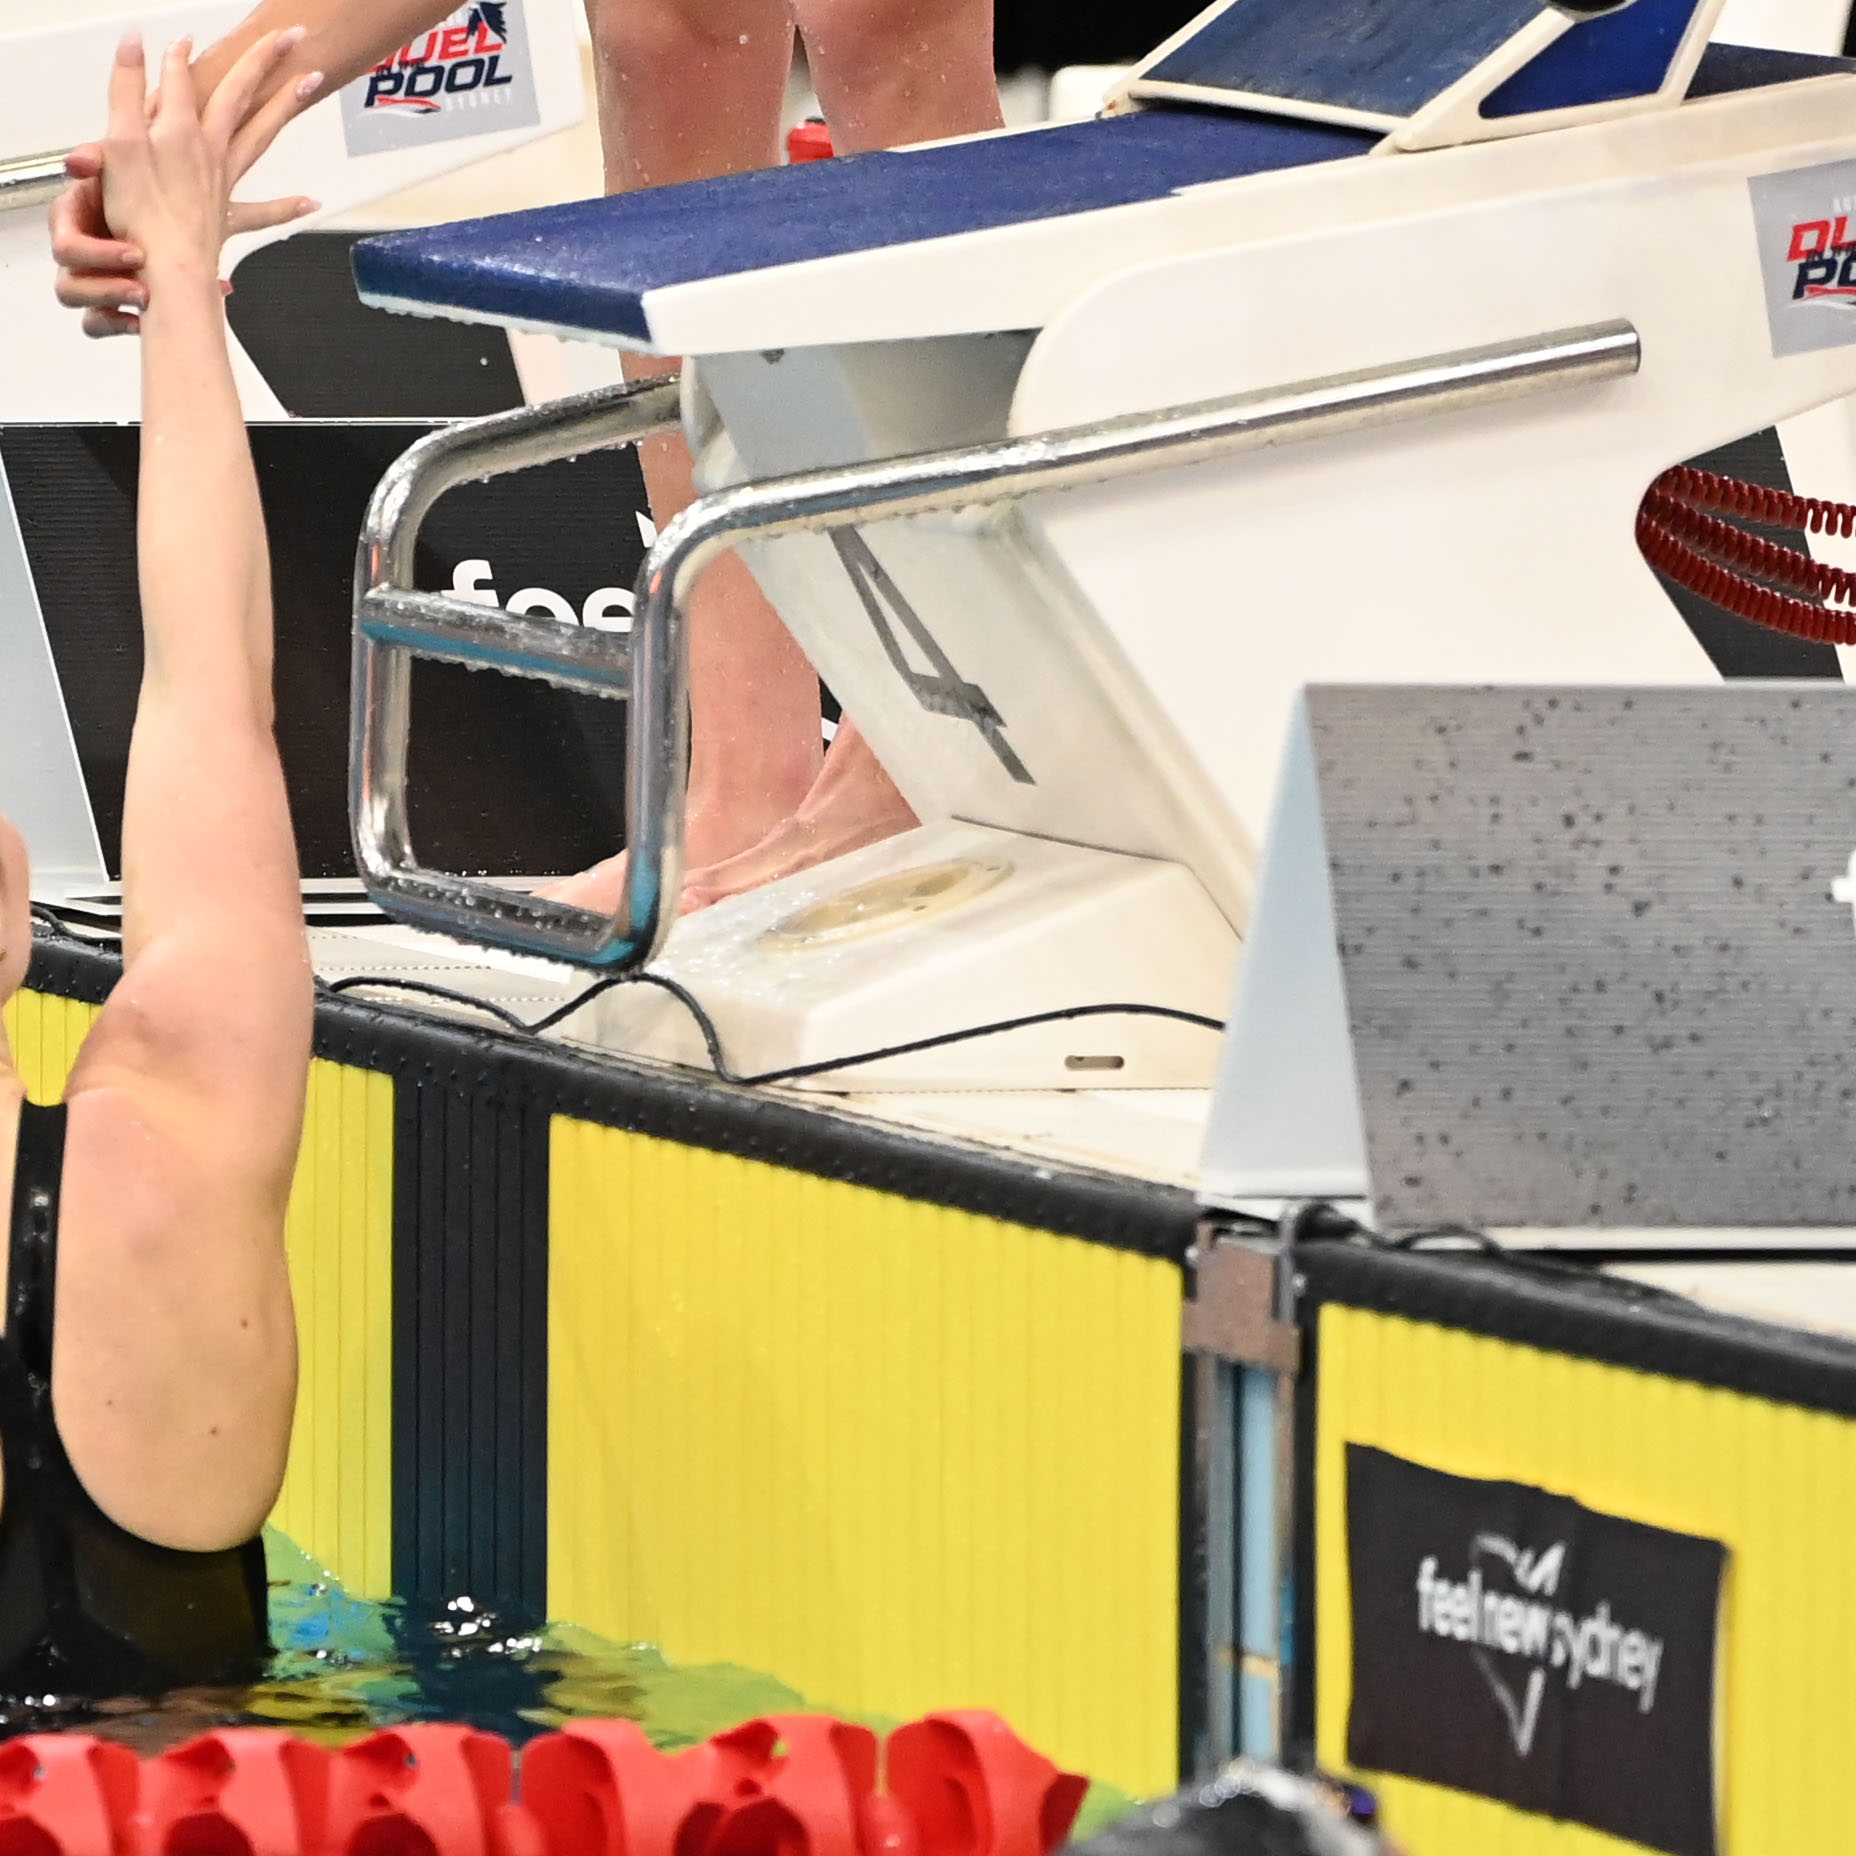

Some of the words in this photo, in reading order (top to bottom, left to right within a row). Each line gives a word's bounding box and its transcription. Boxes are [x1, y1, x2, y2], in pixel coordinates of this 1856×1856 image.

[367, 21, 506, 74] UEL
[363, 54, 513, 108] POOL
[826, 524, 1037, 785] 4
